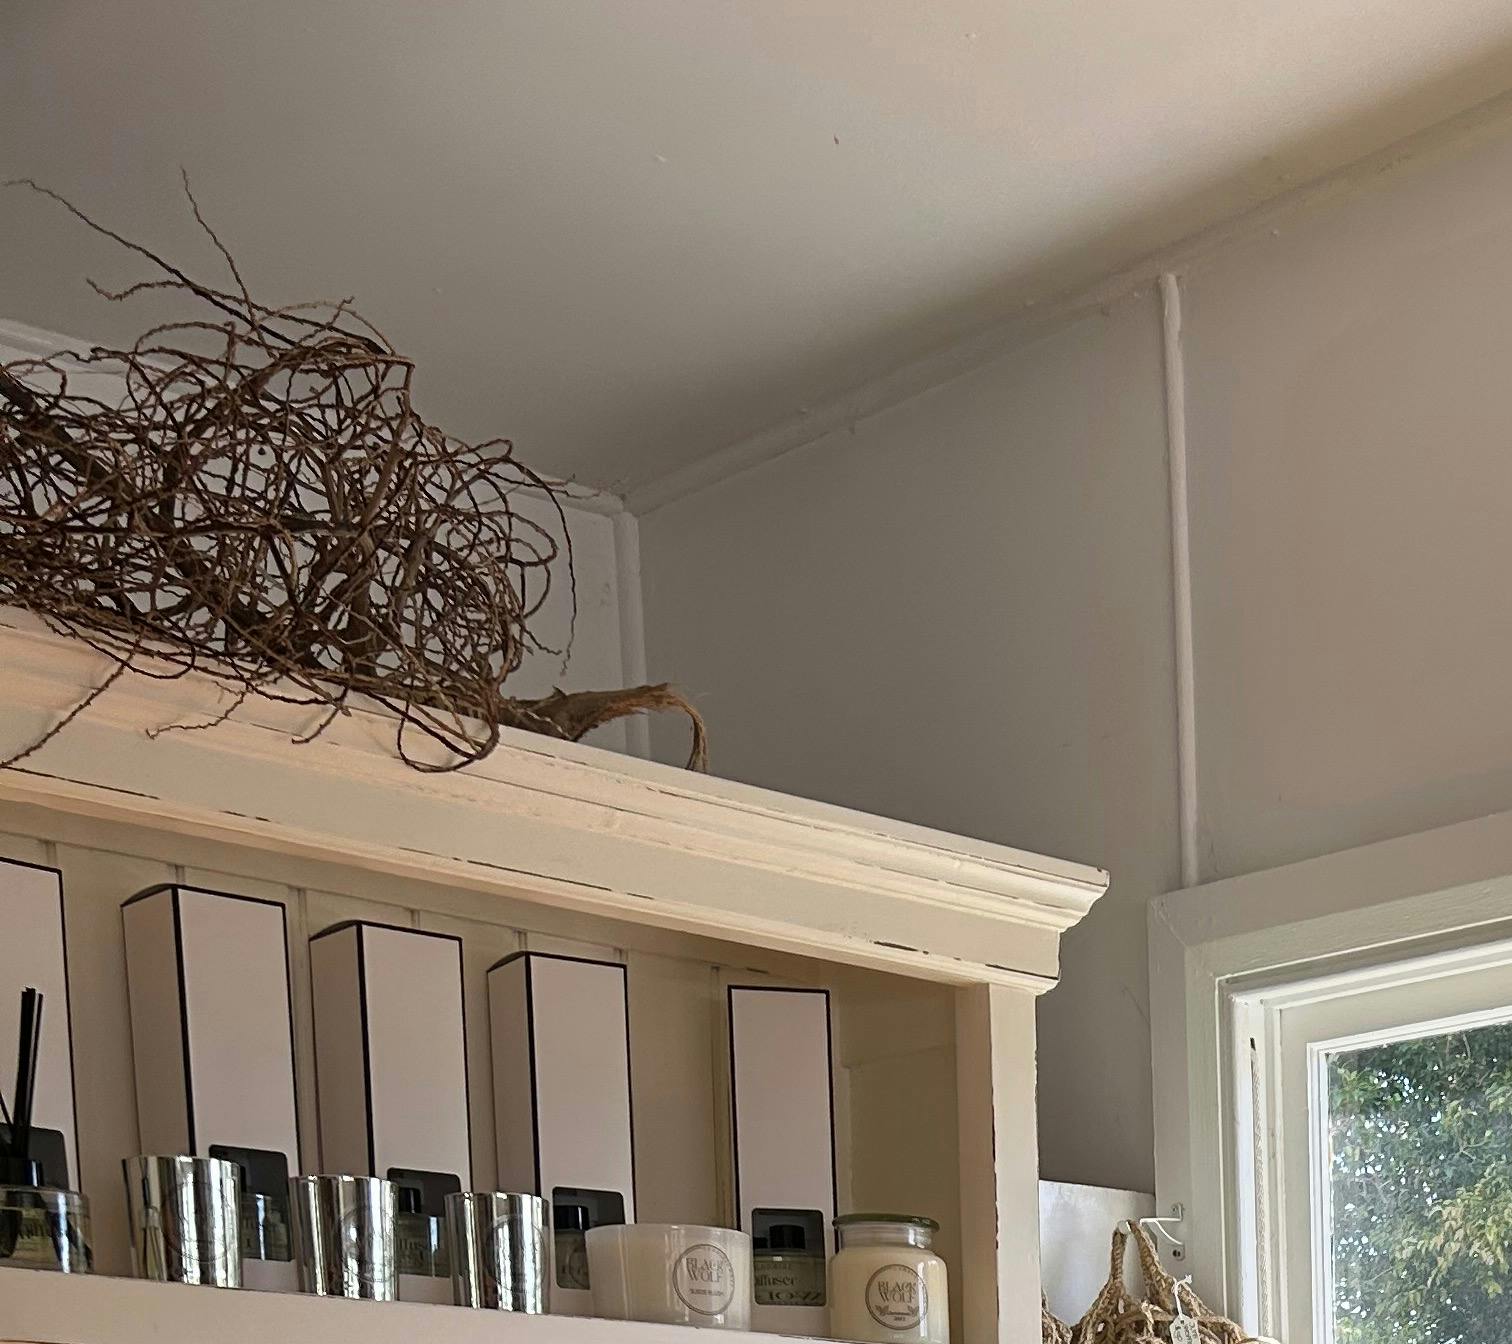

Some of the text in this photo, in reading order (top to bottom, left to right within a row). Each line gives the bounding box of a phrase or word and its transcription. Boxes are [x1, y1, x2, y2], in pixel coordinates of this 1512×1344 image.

[686, 1257, 724, 1272] BLACK
[688, 1268, 722, 1283] WOLF
[877, 1280, 918, 1294] BLACK
[879, 1291, 914, 1304] WOLF
